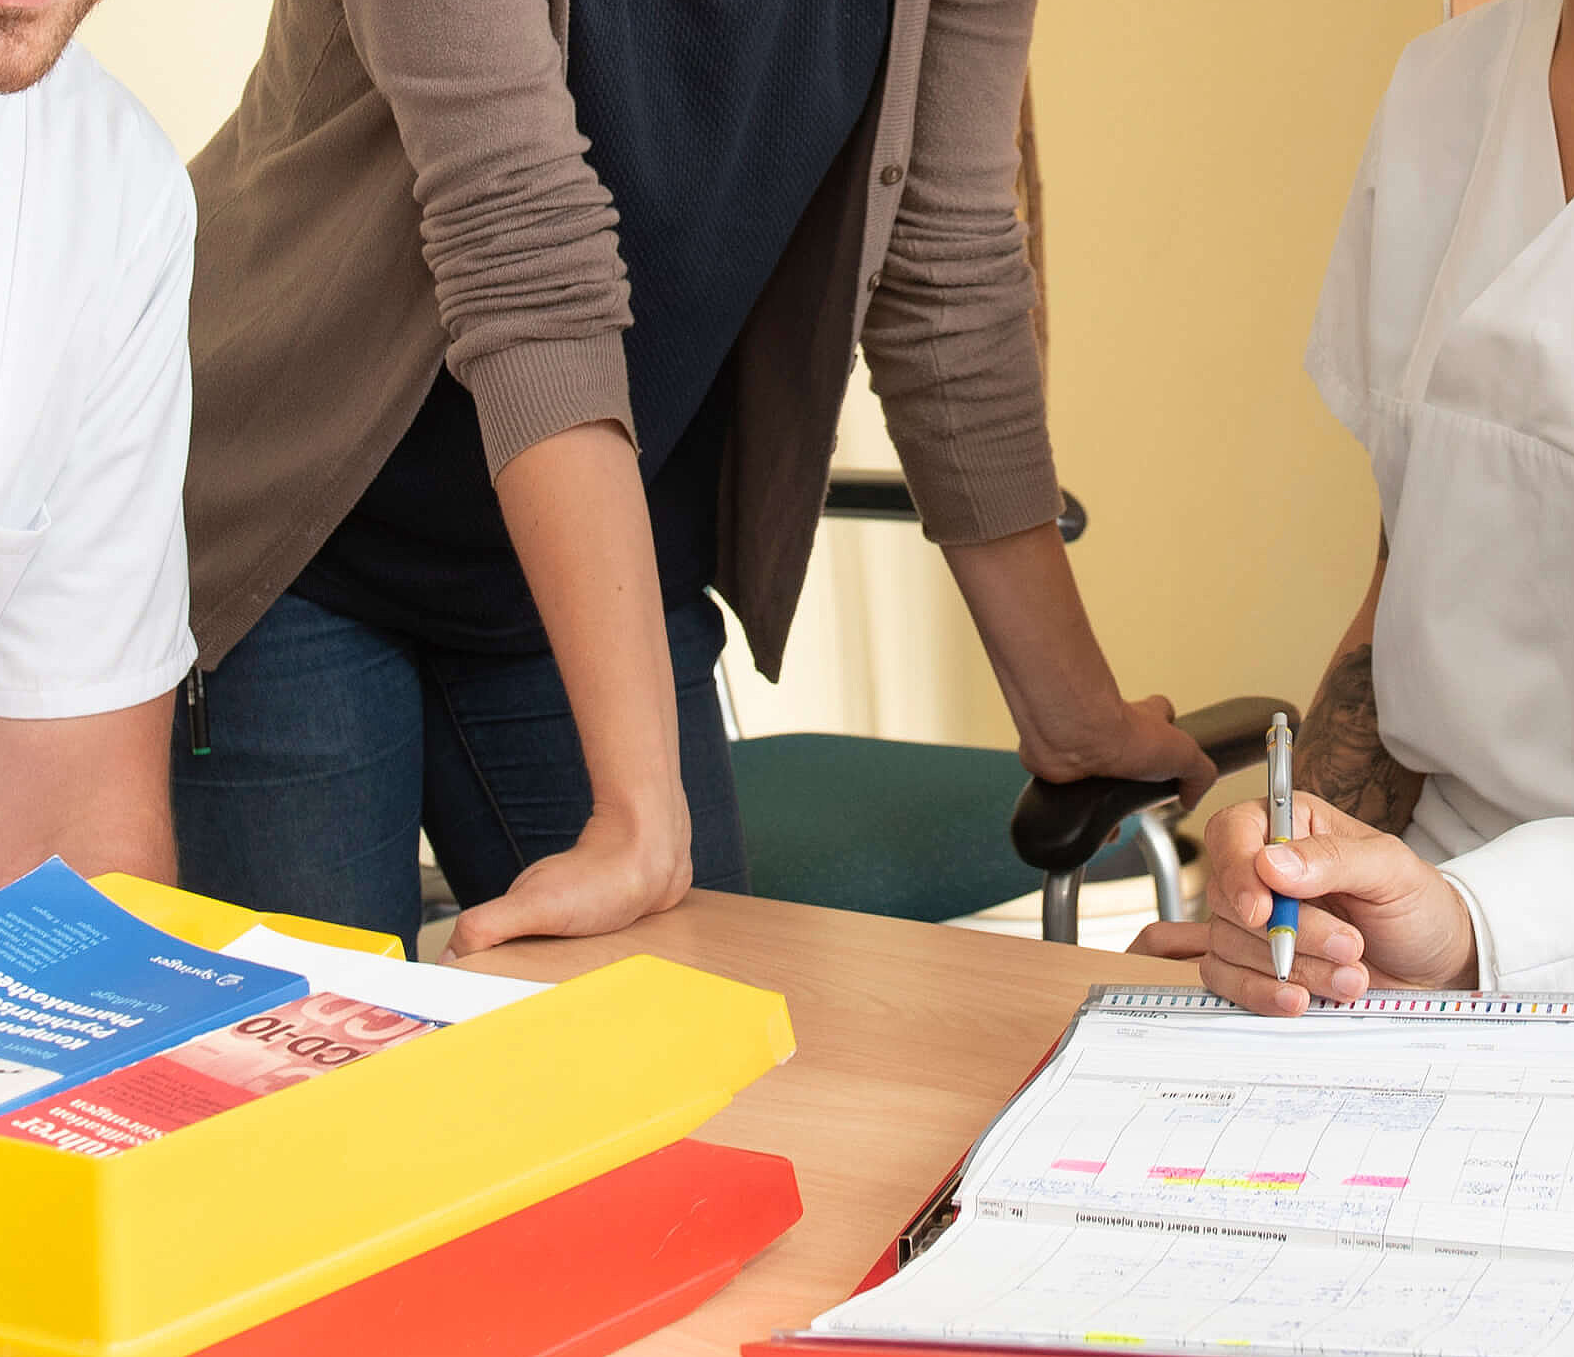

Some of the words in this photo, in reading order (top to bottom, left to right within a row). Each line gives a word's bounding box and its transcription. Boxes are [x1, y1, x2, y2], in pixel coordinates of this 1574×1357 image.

[149, 956, 219, 980] Springer
[90, 990, 147, 1009] Auflage
[1076, 1212, 1133, 1228] Injektionen)
[1136, 1219, 1164, 1231] (auch
[1167, 1223, 1200, 1234] Bedarf
[1203, 1226, 1218, 1236] bei
[1221, 1228, 1288, 1242] Medikamente
